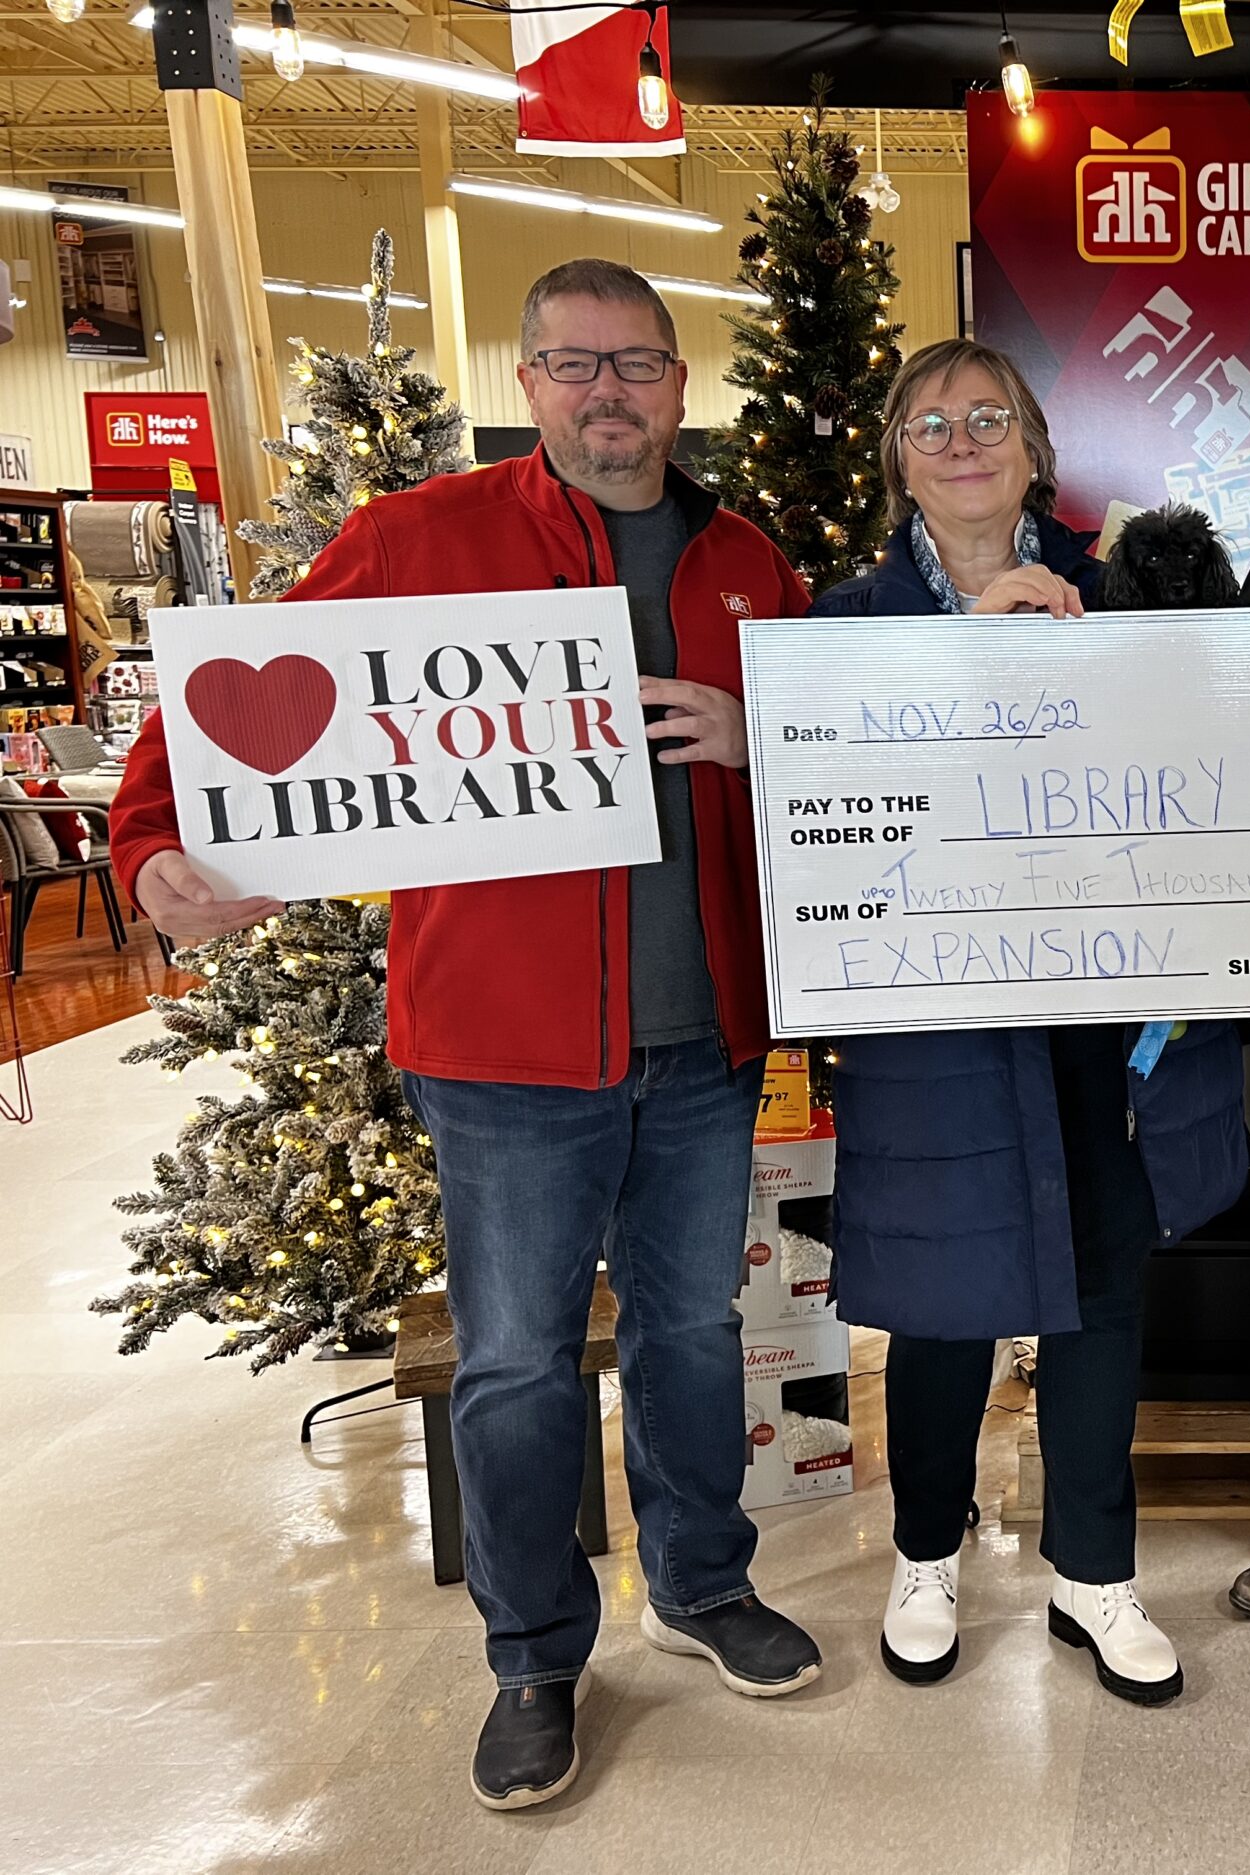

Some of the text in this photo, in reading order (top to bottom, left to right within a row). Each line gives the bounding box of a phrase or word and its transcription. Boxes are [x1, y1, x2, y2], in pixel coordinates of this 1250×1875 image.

[147, 414, 199, 430] Here's
[148, 430, 190, 445] How.
[360, 638, 611, 706] LOVE
[860, 689, 1092, 750] NOV. 26/22
[365, 696, 629, 767] YOUR
[782, 725, 838, 743] Date
[198, 753, 630, 845] LIBRARY
[977, 753, 1224, 837] LIBRARY
[788, 795, 931, 816] PAY TO THE
[790, 826, 914, 846] ORDER OF
[881, 848, 1005, 910] TWENTY
[1015, 849, 1102, 903] FIVE
[795, 902, 889, 922] SUM OF
[838, 928, 1174, 990] EXPANSION
[775, 1092, 789, 1101] 97
[784, 1181, 812, 1189] SHERPA
[803, 1282, 829, 1292] HEAT
[745, 1349, 795, 1367] beam
[745, 1361, 816, 1377] EVERSIBLE SHERPA
[756, 1374, 782, 1382] THROW
[806, 1457, 841, 1470] HEATED
